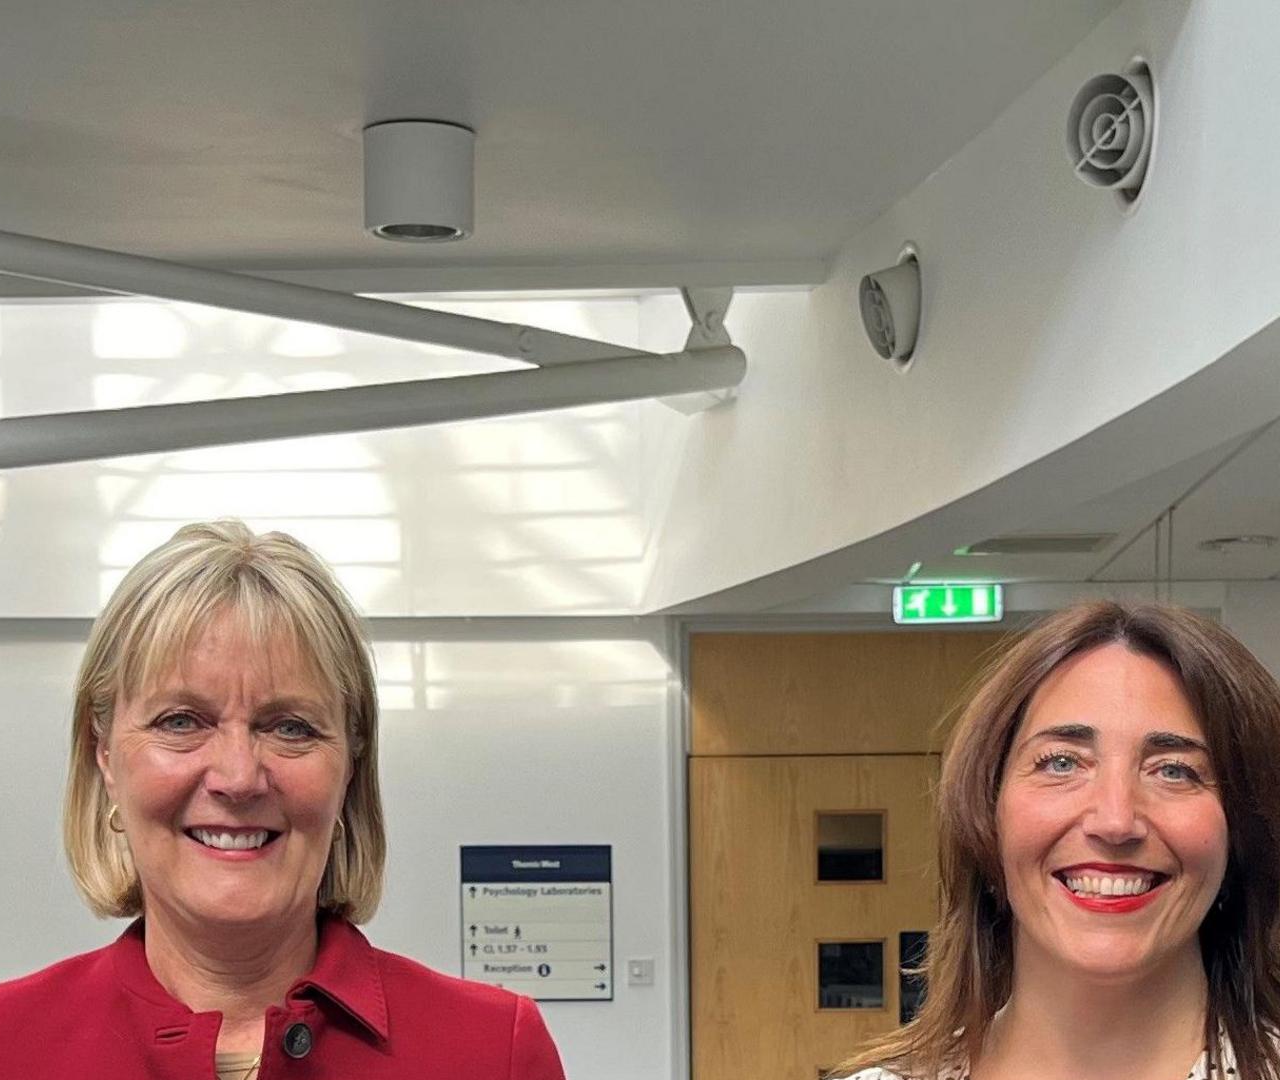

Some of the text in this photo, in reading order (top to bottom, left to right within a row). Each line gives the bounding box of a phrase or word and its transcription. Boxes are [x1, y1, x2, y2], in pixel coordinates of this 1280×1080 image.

[483, 887, 602, 897] Psychology Laboratories
[484, 926, 508, 934] Toilet
[484, 964, 533, 973] Reception
